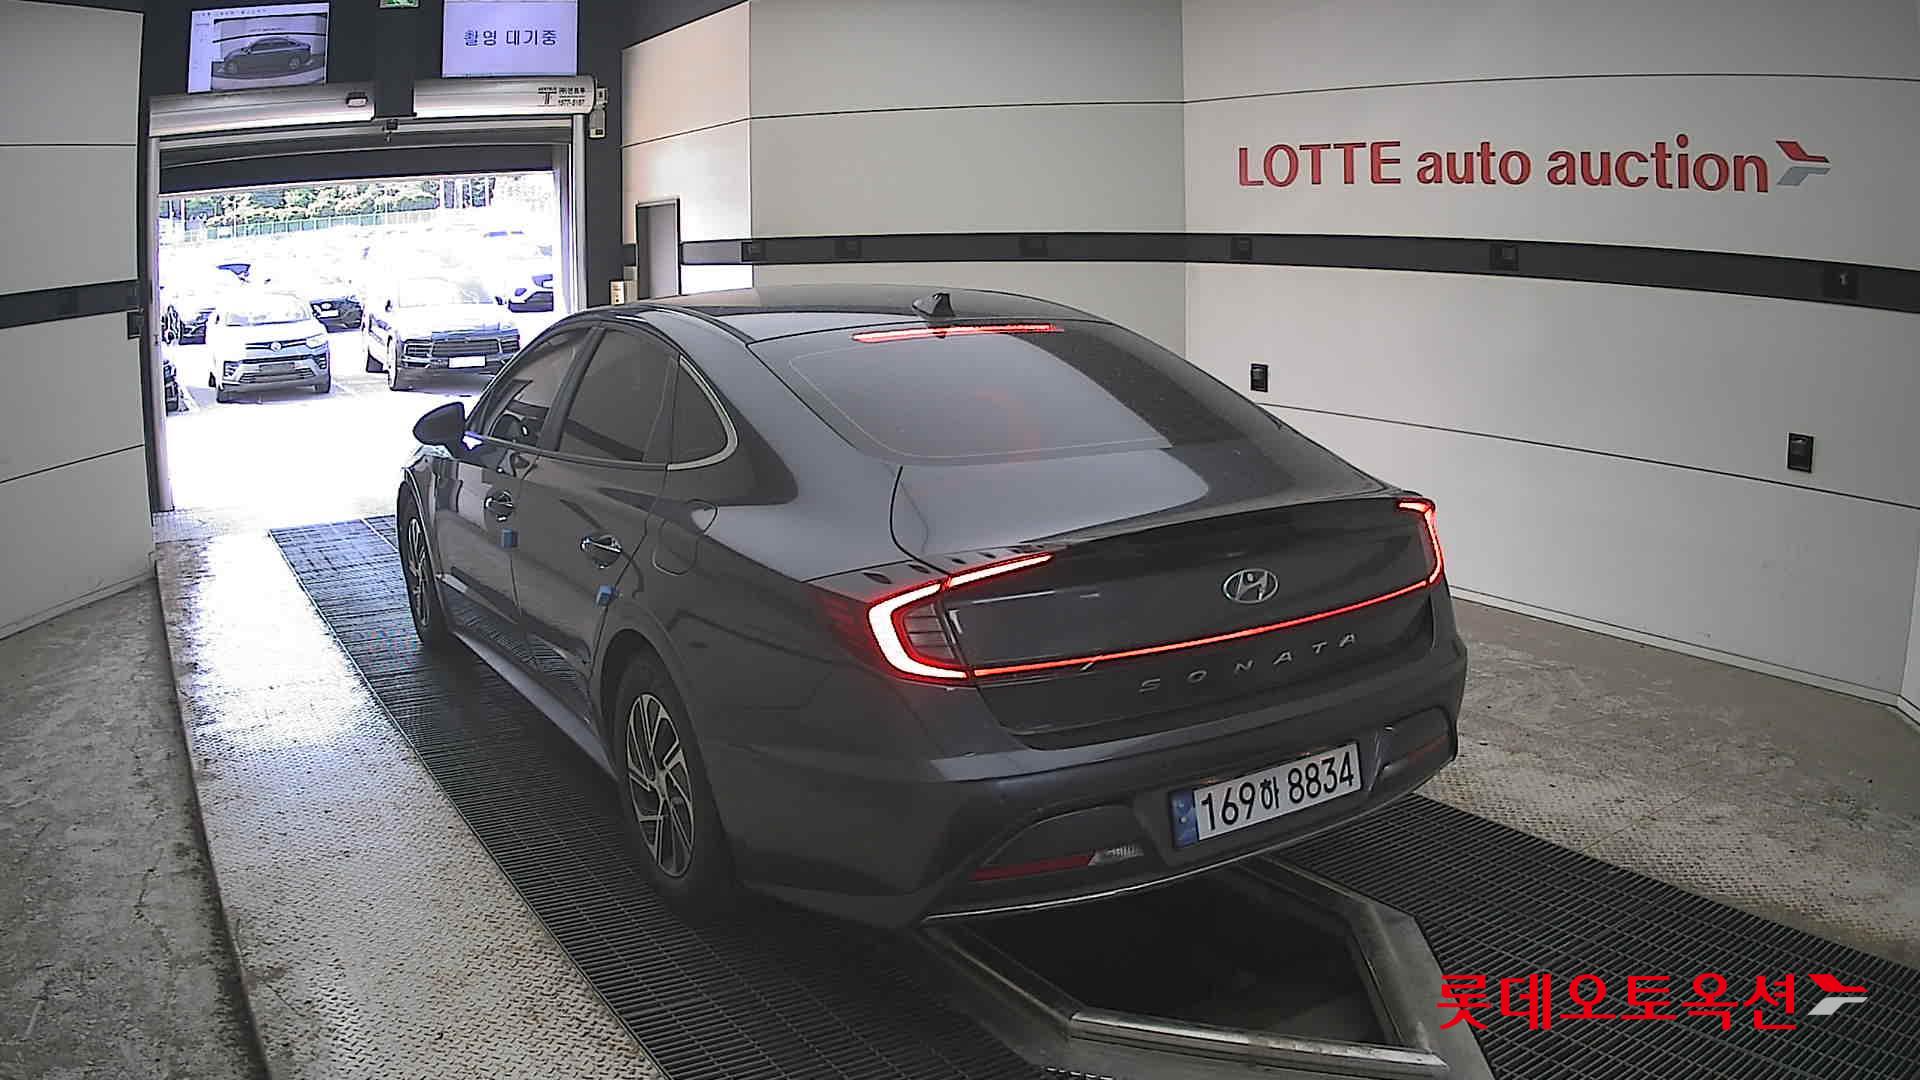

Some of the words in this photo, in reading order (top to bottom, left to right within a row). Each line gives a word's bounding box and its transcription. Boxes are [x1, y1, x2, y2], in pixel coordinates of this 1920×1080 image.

[464, 29, 497, 46] 촬영
[505, 29, 557, 46] 대기중
[1237, 140, 1401, 187] LOTTE
[1416, 140, 1532, 185] auto
[1546, 134, 1769, 193] auction
[1139, 633, 1357, 693] SONATA
[1201, 776, 1280, 831] 169하
[1287, 751, 1355, 804] 8834
